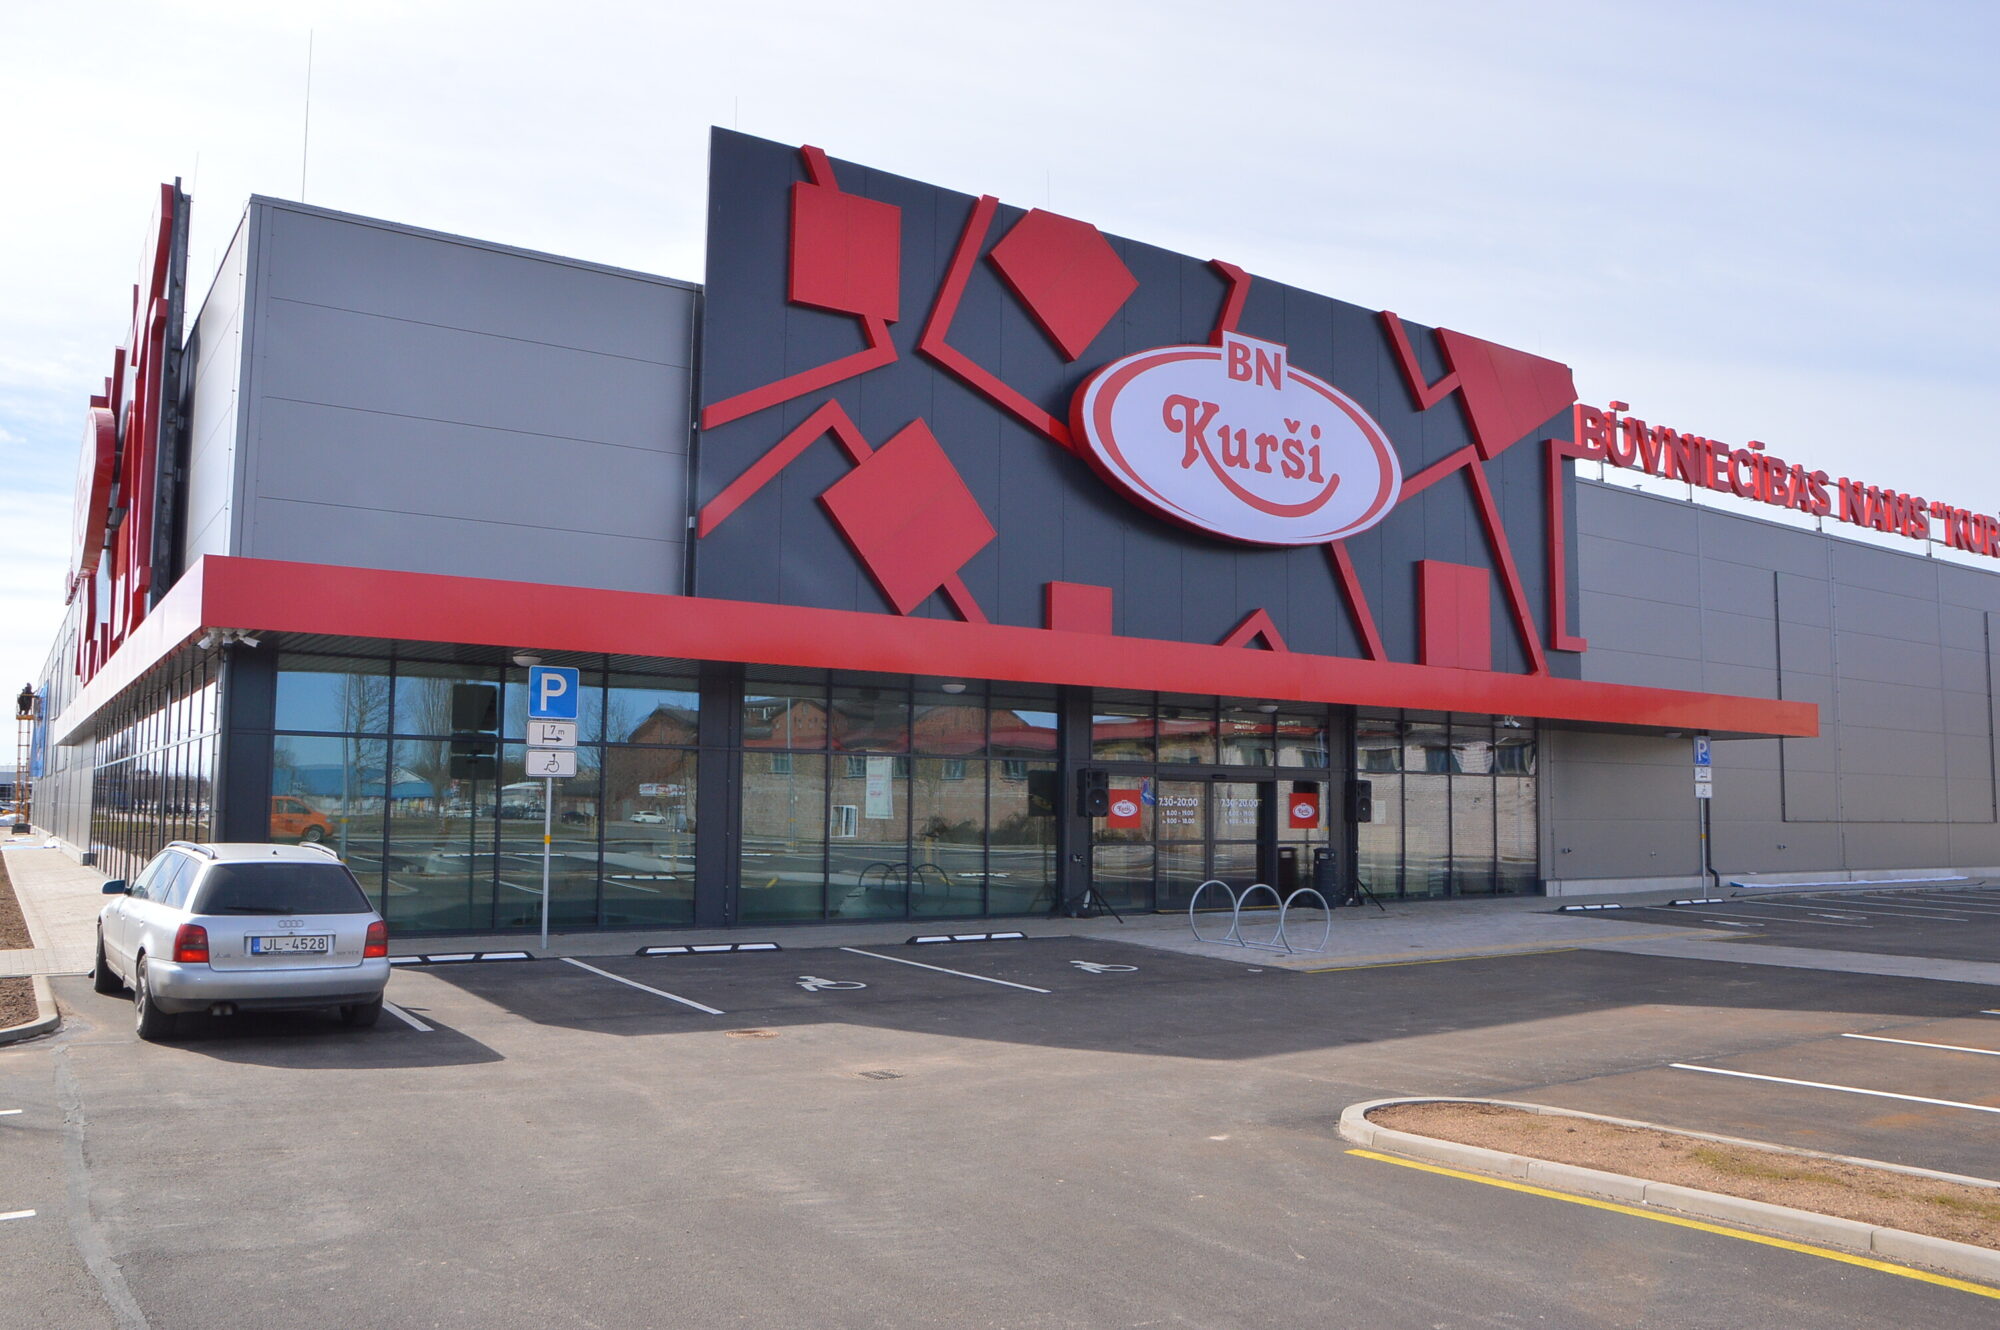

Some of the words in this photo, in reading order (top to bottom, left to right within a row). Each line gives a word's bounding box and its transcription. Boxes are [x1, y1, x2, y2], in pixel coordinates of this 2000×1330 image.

[1228, 341, 1282, 391] BN
[1162, 394, 1341, 518] Kurši
[1574, 400, 1832, 517] BŪVNIECĪBAS
[1838, 477, 1929, 540] NAMS
[1930, 501, 2000, 559] "KUR
[540, 673, 567, 711] P
[550, 725, 556, 735] 7
